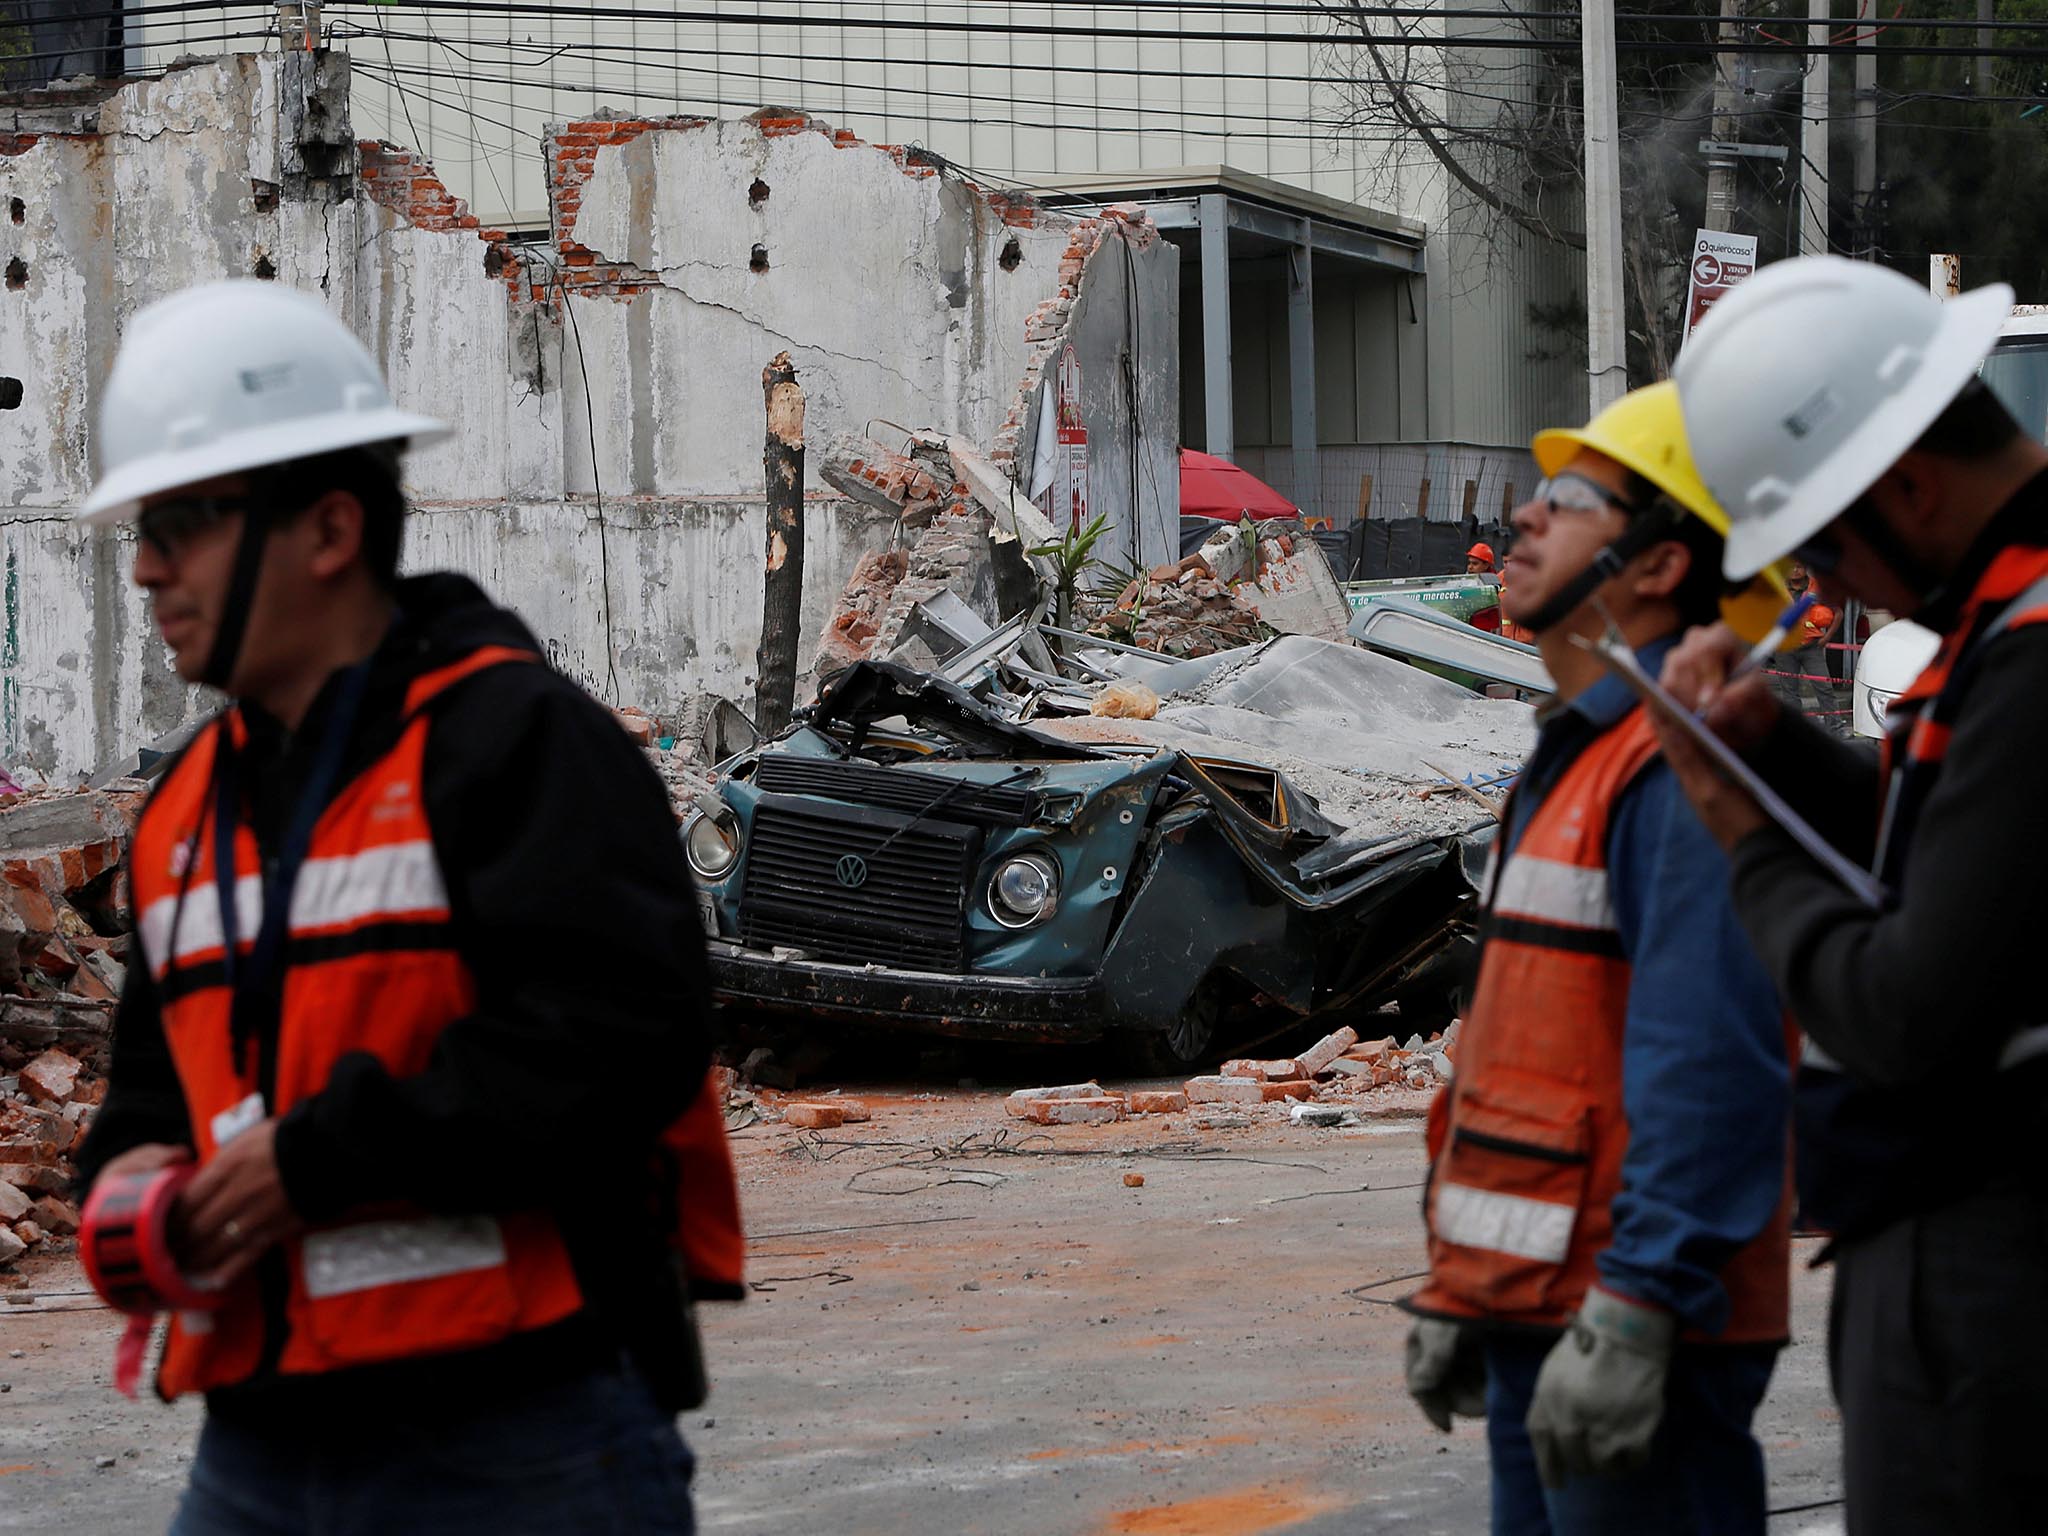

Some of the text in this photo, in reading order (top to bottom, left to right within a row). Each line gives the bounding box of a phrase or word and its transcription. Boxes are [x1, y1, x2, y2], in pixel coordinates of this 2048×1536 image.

[1708, 243, 1751, 256] quierocasa
[1727, 265, 1748, 274] VENTA
[1422, 590, 1463, 600] mereces.
